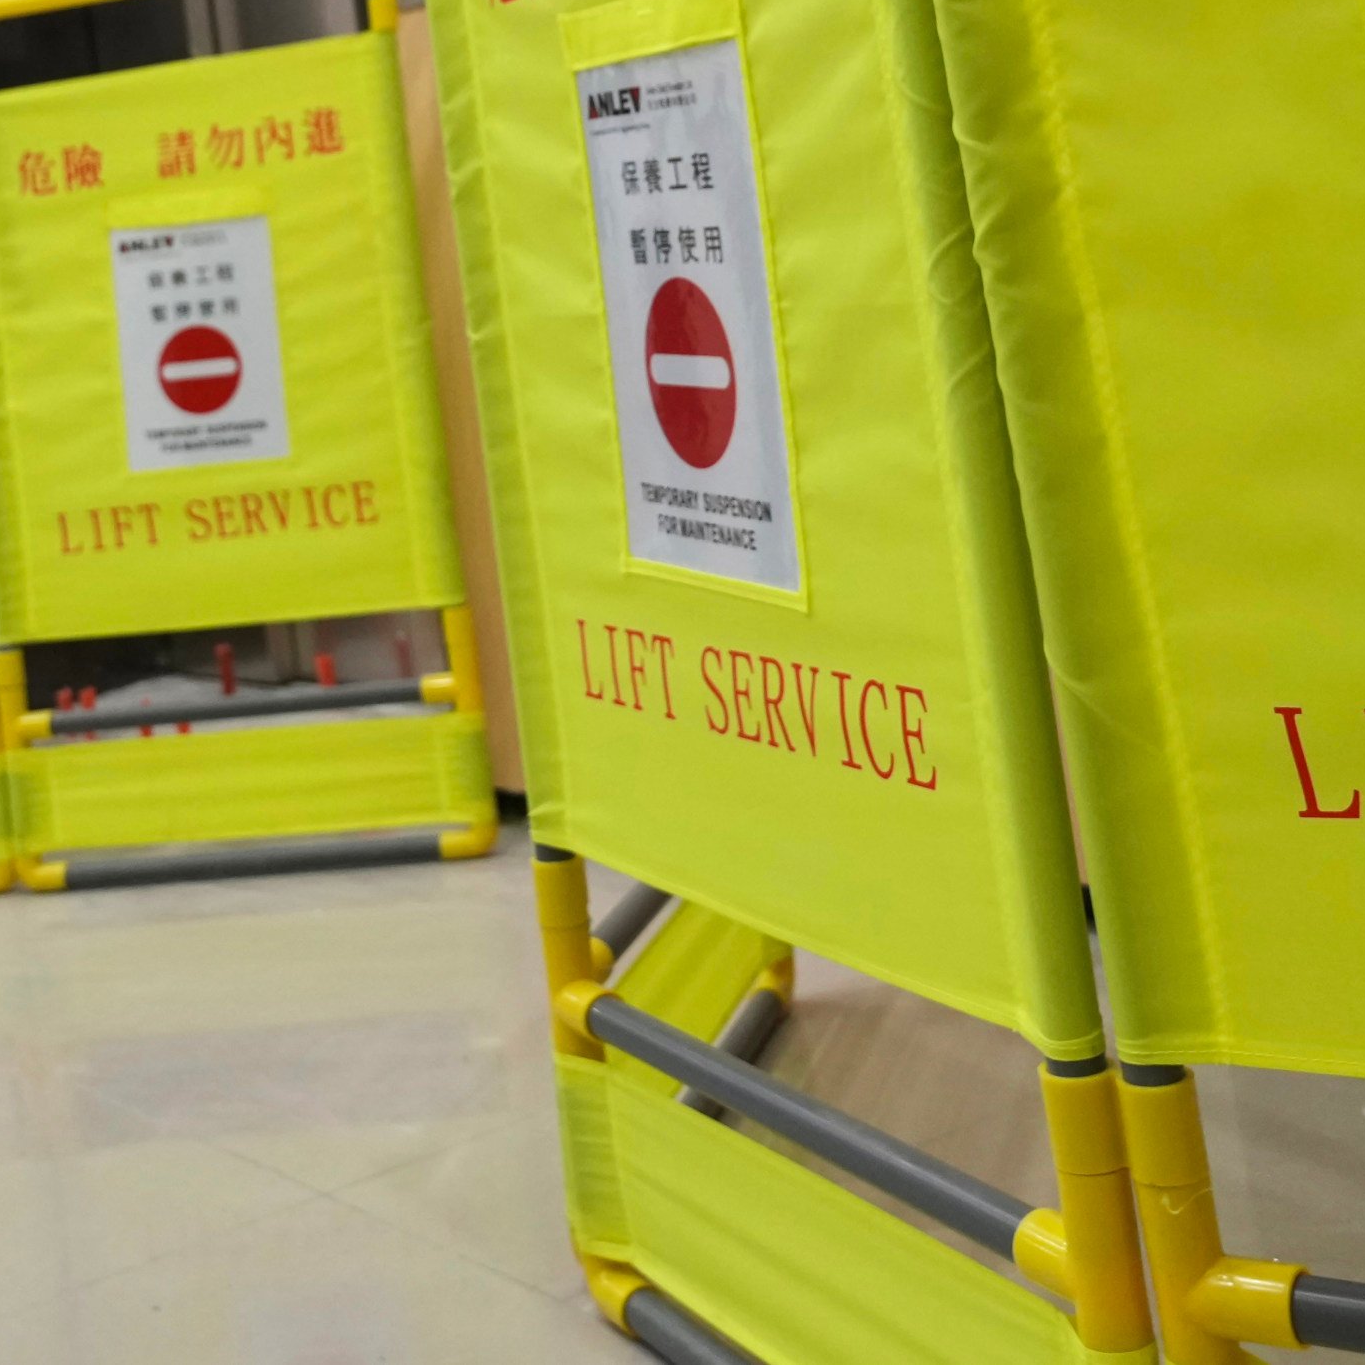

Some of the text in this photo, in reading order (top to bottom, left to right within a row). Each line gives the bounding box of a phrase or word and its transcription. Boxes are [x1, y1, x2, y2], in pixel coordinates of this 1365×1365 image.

[588, 86, 641, 120] ANLEV
[17, 142, 105, 198] 危險
[57, 478, 380, 556] LIFT SERVICE
[577, 619, 938, 792] LIFT SERVICE
